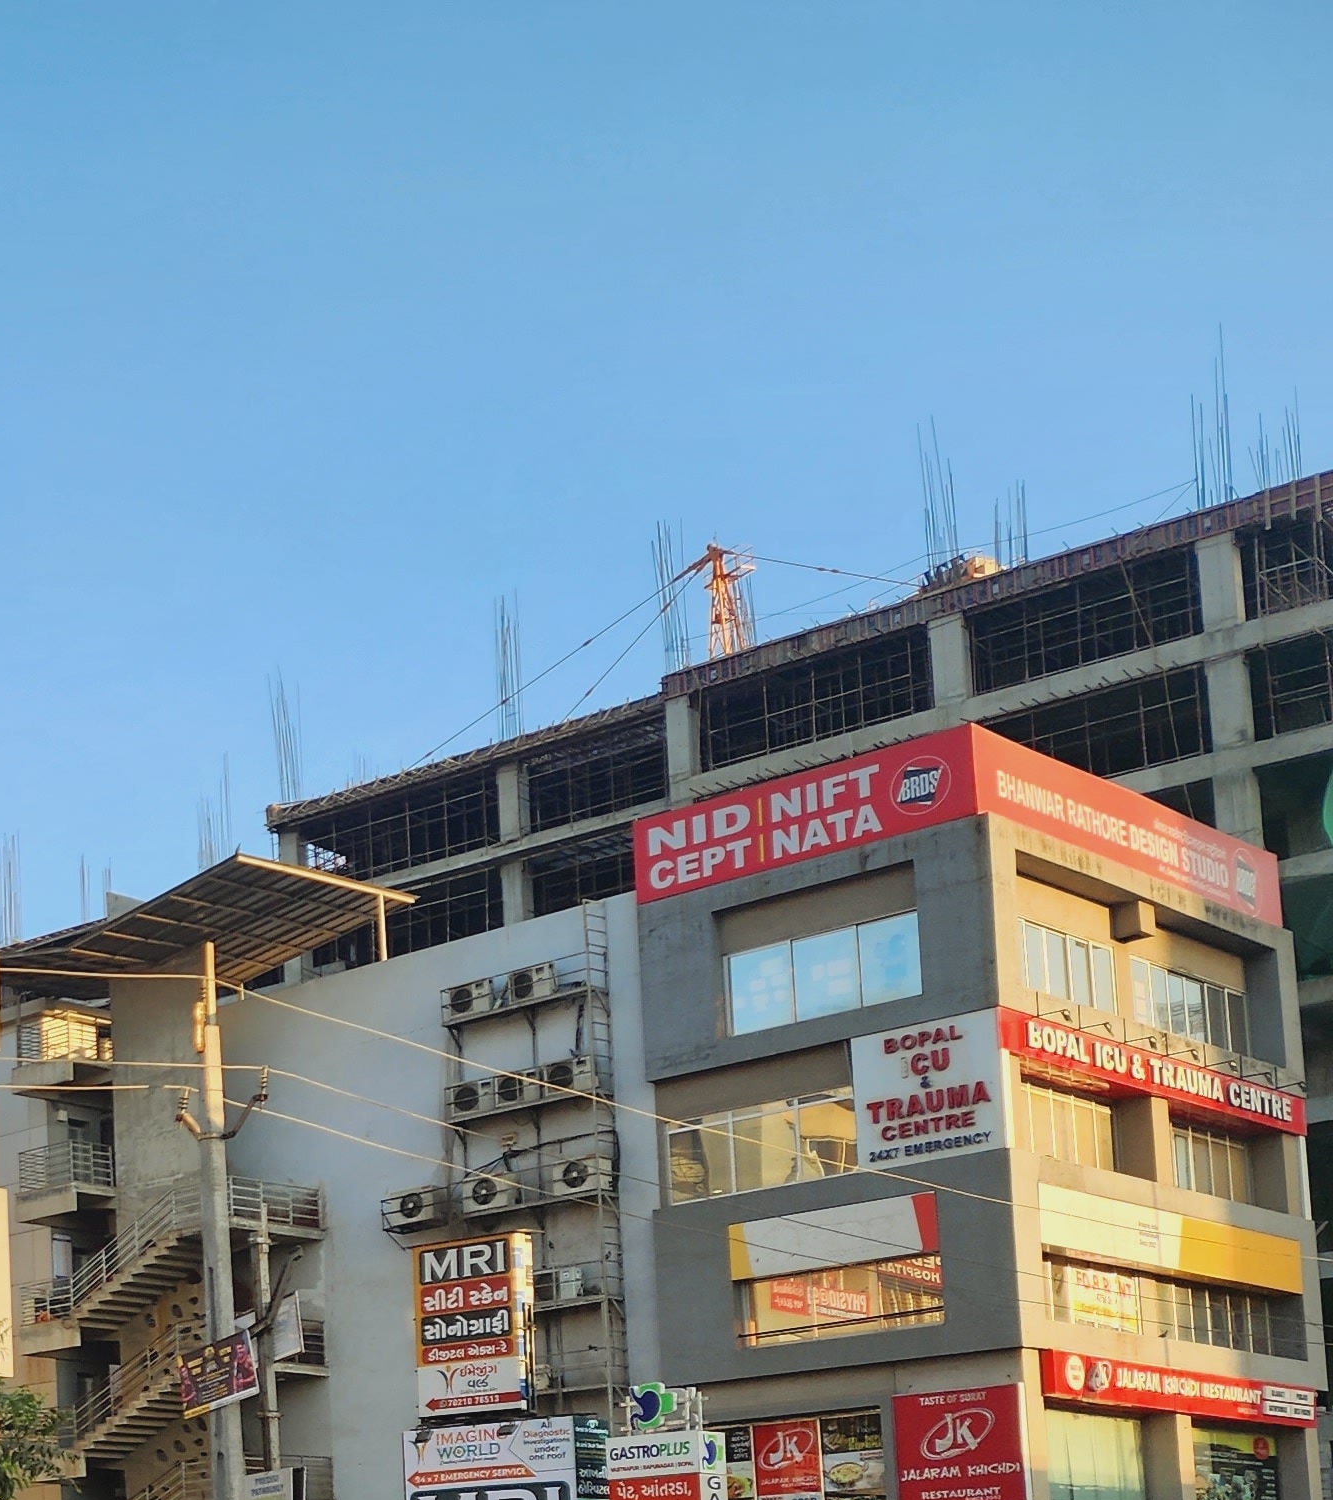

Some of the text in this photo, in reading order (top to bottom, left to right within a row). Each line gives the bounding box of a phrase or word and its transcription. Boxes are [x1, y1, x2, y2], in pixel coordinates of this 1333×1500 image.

[648, 764, 942, 856] NID NIFT BRDS
[996, 771, 1066, 823] BHANWAR
[1067, 799, 1128, 847] RATHORE
[1129, 824, 1180, 867] DESIGN
[1181, 847, 1230, 888] STUDIO
[649, 804, 883, 889] CEPT NATA
[883, 1025, 963, 1055] BOPAL
[900, 1048, 951, 1079] ICU
[1026, 1020, 1293, 1123] BOPAL ICU & TRAUMA CENTRE
[866, 1081, 992, 1125] TRAUMA
[881, 1110, 976, 1142] CENTRE
[869, 1132, 992, 1163] 24X7 EMERGENCY
[422, 1240, 506, 1284] MRI
[423, 1283, 509, 1313] સીટી સ્કેન
[920, 1396, 946, 1406] TASTE
[959, 1391, 987, 1403] SURAT
[1116, 1368, 1162, 1393] JALARAM
[1164, 1375, 1201, 1398] KHICHDI
[1203, 1383, 1262, 1405] RESTAURANT
[523, 1428, 571, 1438] Diagnostic
[437, 1443, 501, 1459] WORLD
[547, 1452, 566, 1460] roof
[609, 1441, 691, 1461] GASTROPLUS
[440, 1467, 527, 1481] EMERGENCY SERVICE
[901, 1462, 1021, 1482] JALARAM KHICHDI
[921, 1486, 1002, 1500] RESTAURANT
